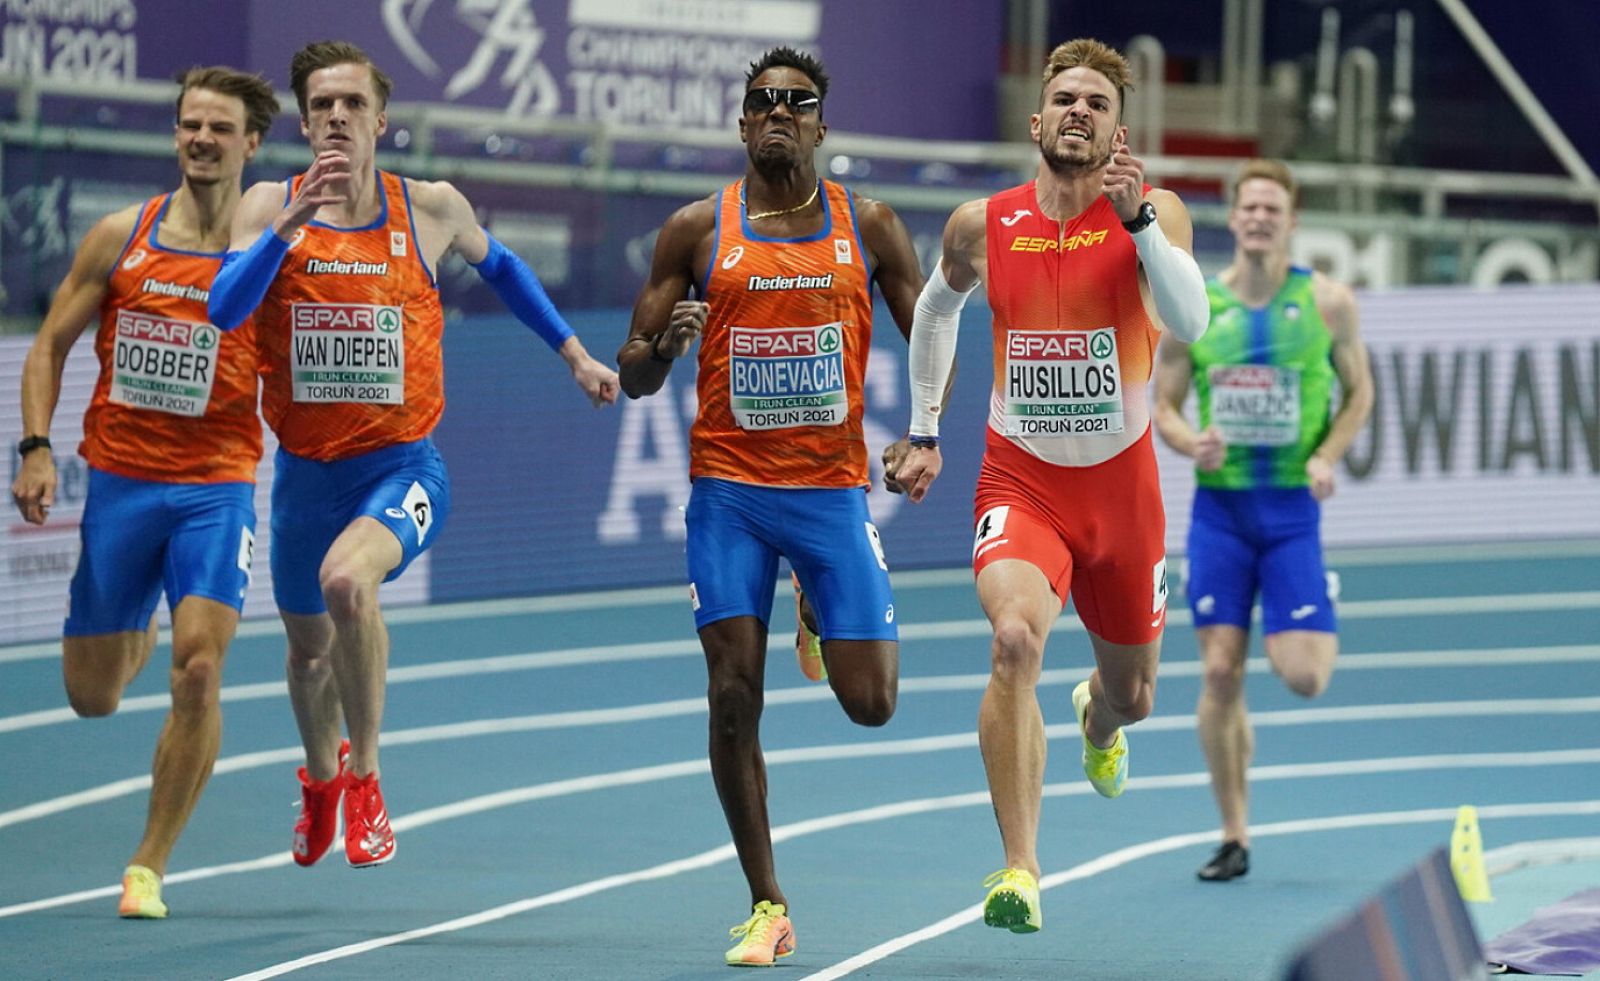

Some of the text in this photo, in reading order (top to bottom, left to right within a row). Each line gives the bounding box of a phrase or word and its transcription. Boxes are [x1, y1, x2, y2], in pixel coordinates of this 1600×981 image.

[50, 26, 137, 82] 2021
[1010, 229, 1108, 253] ESPAÑA
[297, 309, 373, 328] SPAR
[118, 315, 190, 344] SPAR
[295, 336, 399, 368] VAN DIEPEN
[734, 334, 814, 354] SPAR
[1010, 336, 1086, 357] SPAR
[117, 342, 209, 384] DOBBER
[735, 356, 842, 394] BONEVACIA
[1010, 364, 1116, 398] HUSILLOS
[307, 384, 390, 400] TORUŃ 2021
[166, 397, 195, 412] 2021
[759, 399, 783, 409] RUN
[1032, 405, 1055, 414] RUN
[747, 409, 835, 426] TORUŃ 2021
[1020, 417, 1108, 433] TORUŃ 2021
[978, 514, 992, 540] 4
